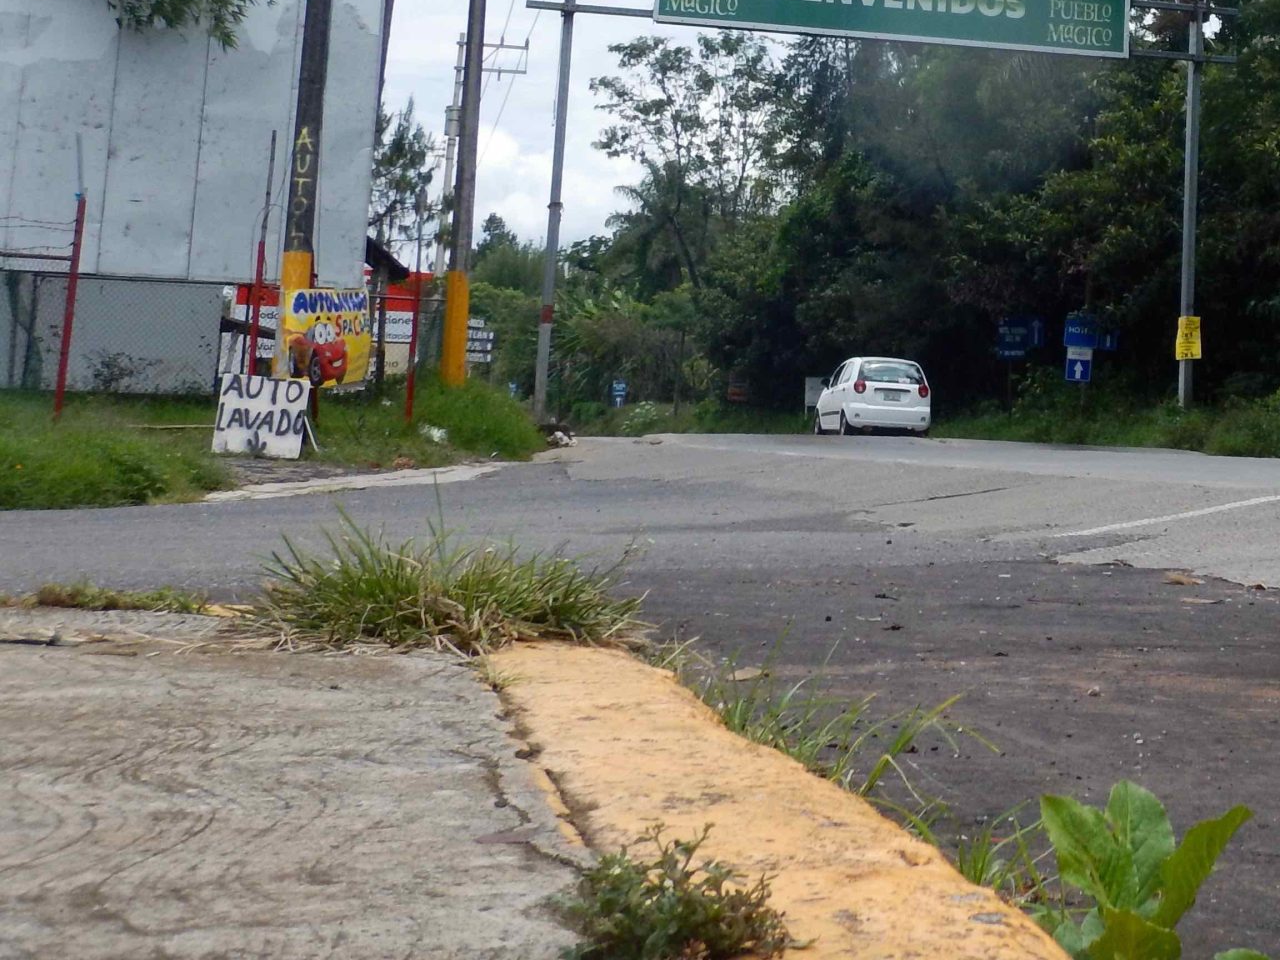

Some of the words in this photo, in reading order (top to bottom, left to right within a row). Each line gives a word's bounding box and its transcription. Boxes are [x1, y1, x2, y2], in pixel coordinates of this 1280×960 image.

[1048, 0, 1113, 24] PUEBLO
[222, 375, 304, 406] AUTO
[215, 401, 306, 437] LAVADO
